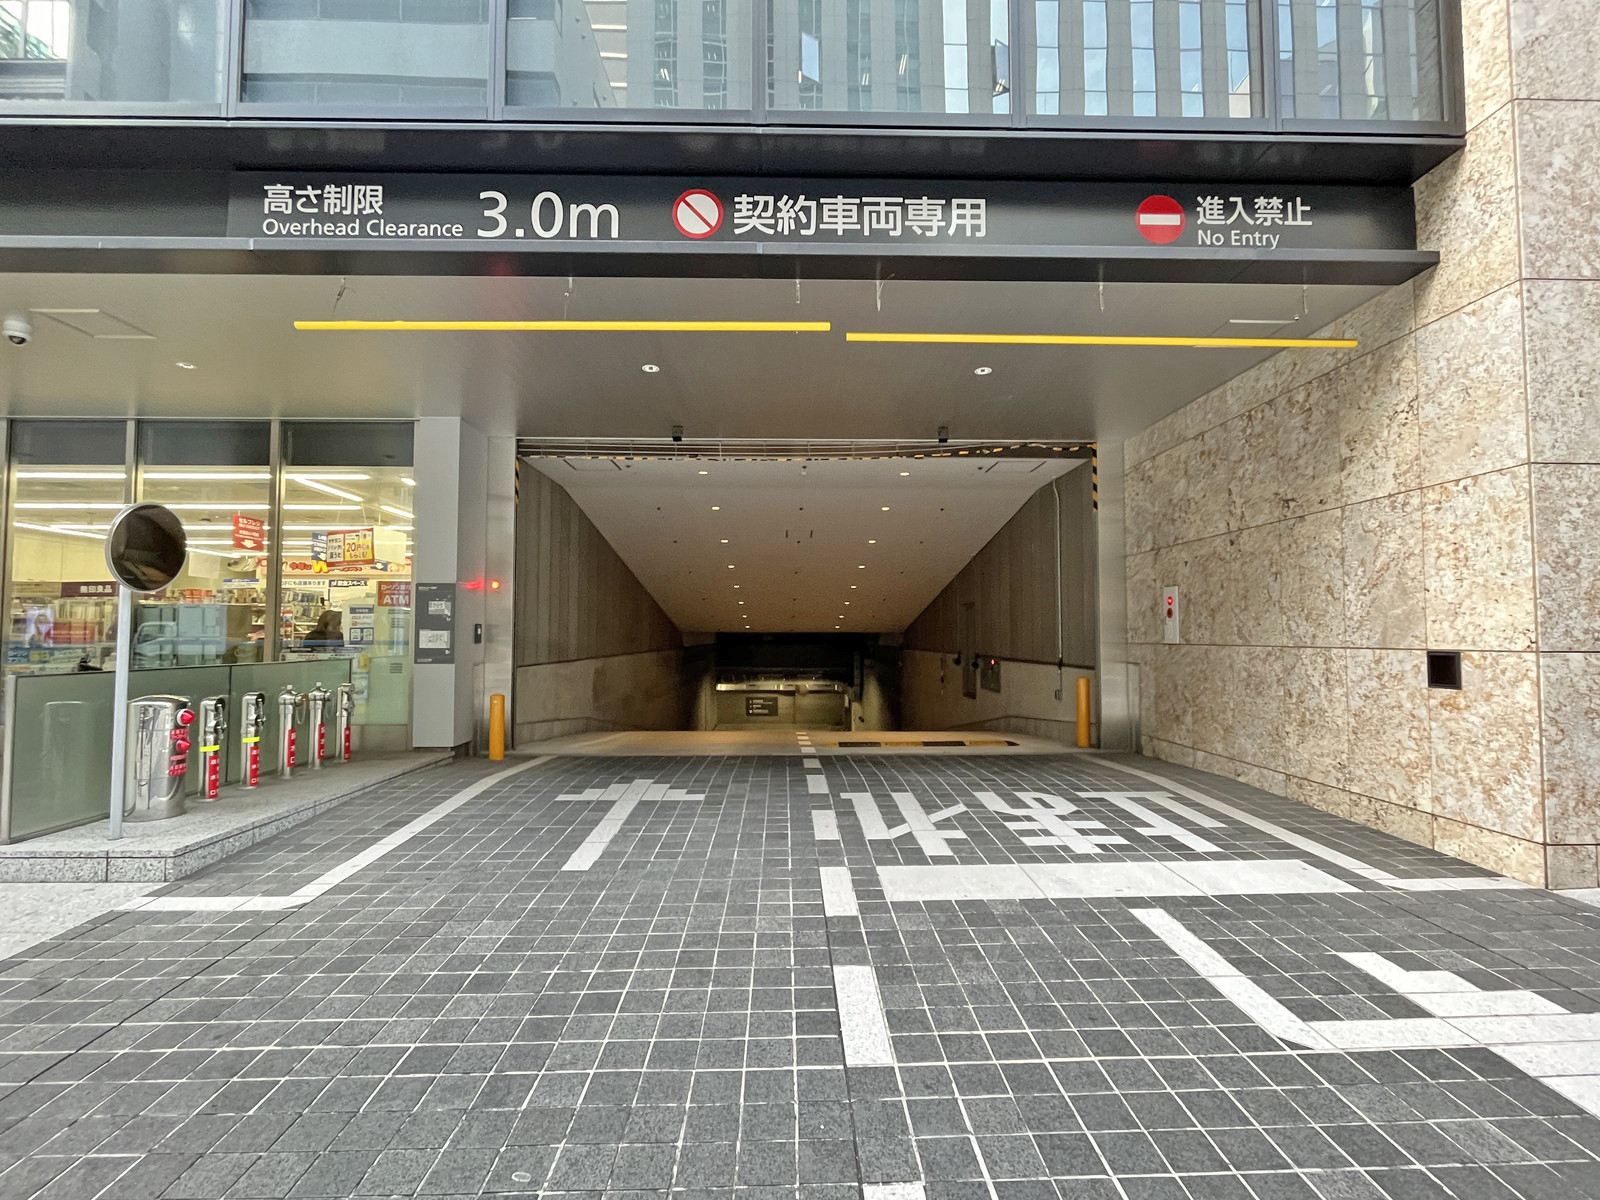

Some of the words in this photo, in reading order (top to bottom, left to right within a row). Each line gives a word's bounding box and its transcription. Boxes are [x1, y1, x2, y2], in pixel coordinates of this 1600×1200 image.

[263, 184, 383, 215] 高さ制限
[476, 190, 619, 239] 3.0m
[1196, 195, 1313, 228] 進入禁止
[262, 218, 360, 237] Overhead
[366, 219, 464, 238] Clearance
[733, 193, 988, 238] 契約車両専用
[1197, 230, 1225, 247] No
[1231, 230, 1280, 251] Entry
[383, 595, 409, 605] ATM
